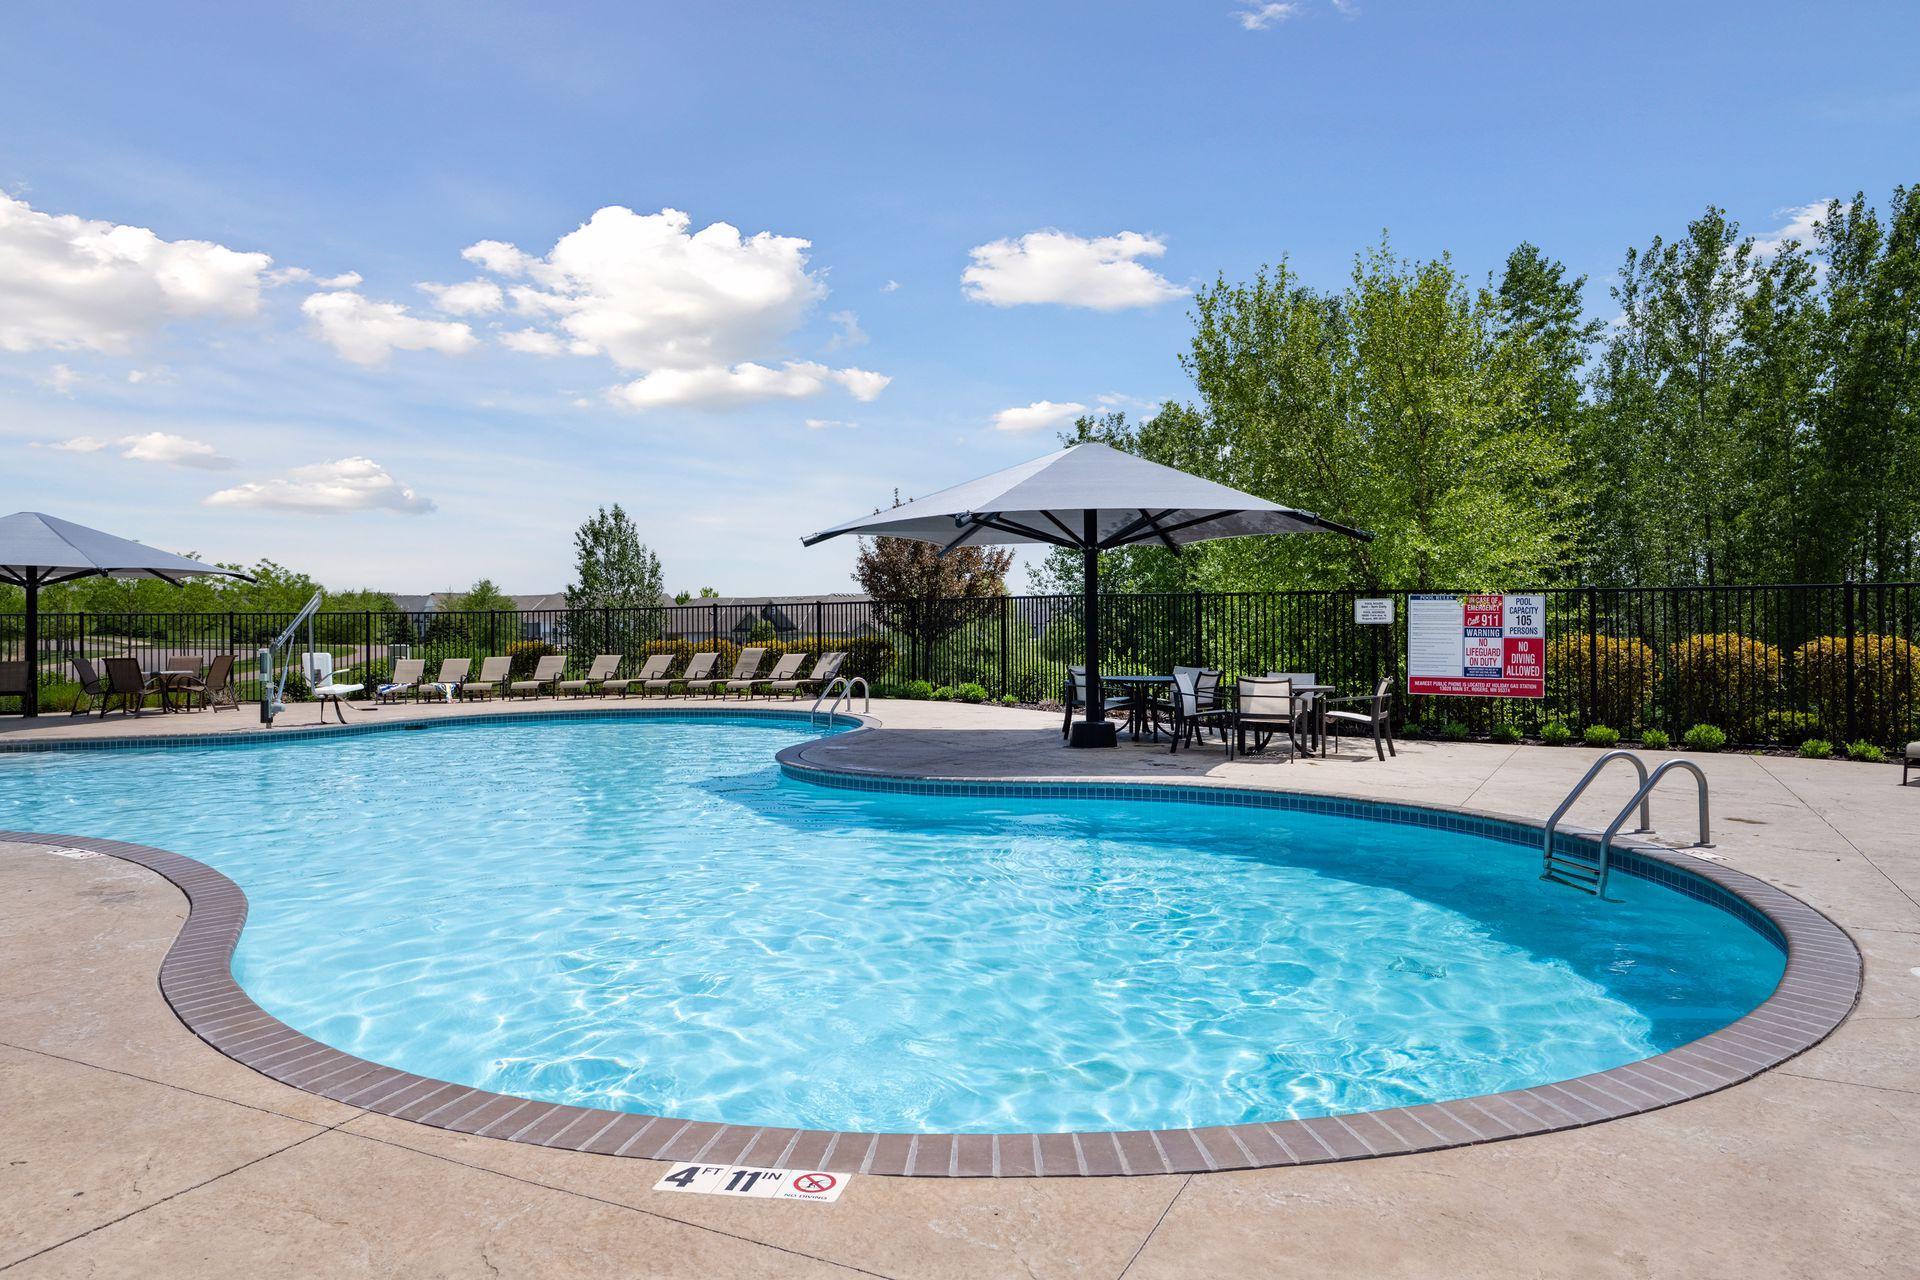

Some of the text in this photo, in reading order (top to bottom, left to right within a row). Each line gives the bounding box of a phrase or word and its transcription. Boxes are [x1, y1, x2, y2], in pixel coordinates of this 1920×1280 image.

[1467, 614, 1499, 626] Call 911
[1516, 615, 1532, 626] 105
[1467, 628, 1500, 637] WARNING
[1479, 638, 1488, 646] NO
[1518, 641, 1528, 652] NO
[1466, 648, 1500, 656] LIFEGUARD
[1470, 657, 1497, 666] ON DUTY
[1511, 653, 1535, 664] DIVING
[1506, 666, 1540, 677] ALLOWED
[664, 1166, 783, 1192] 4 FT 11 IN
